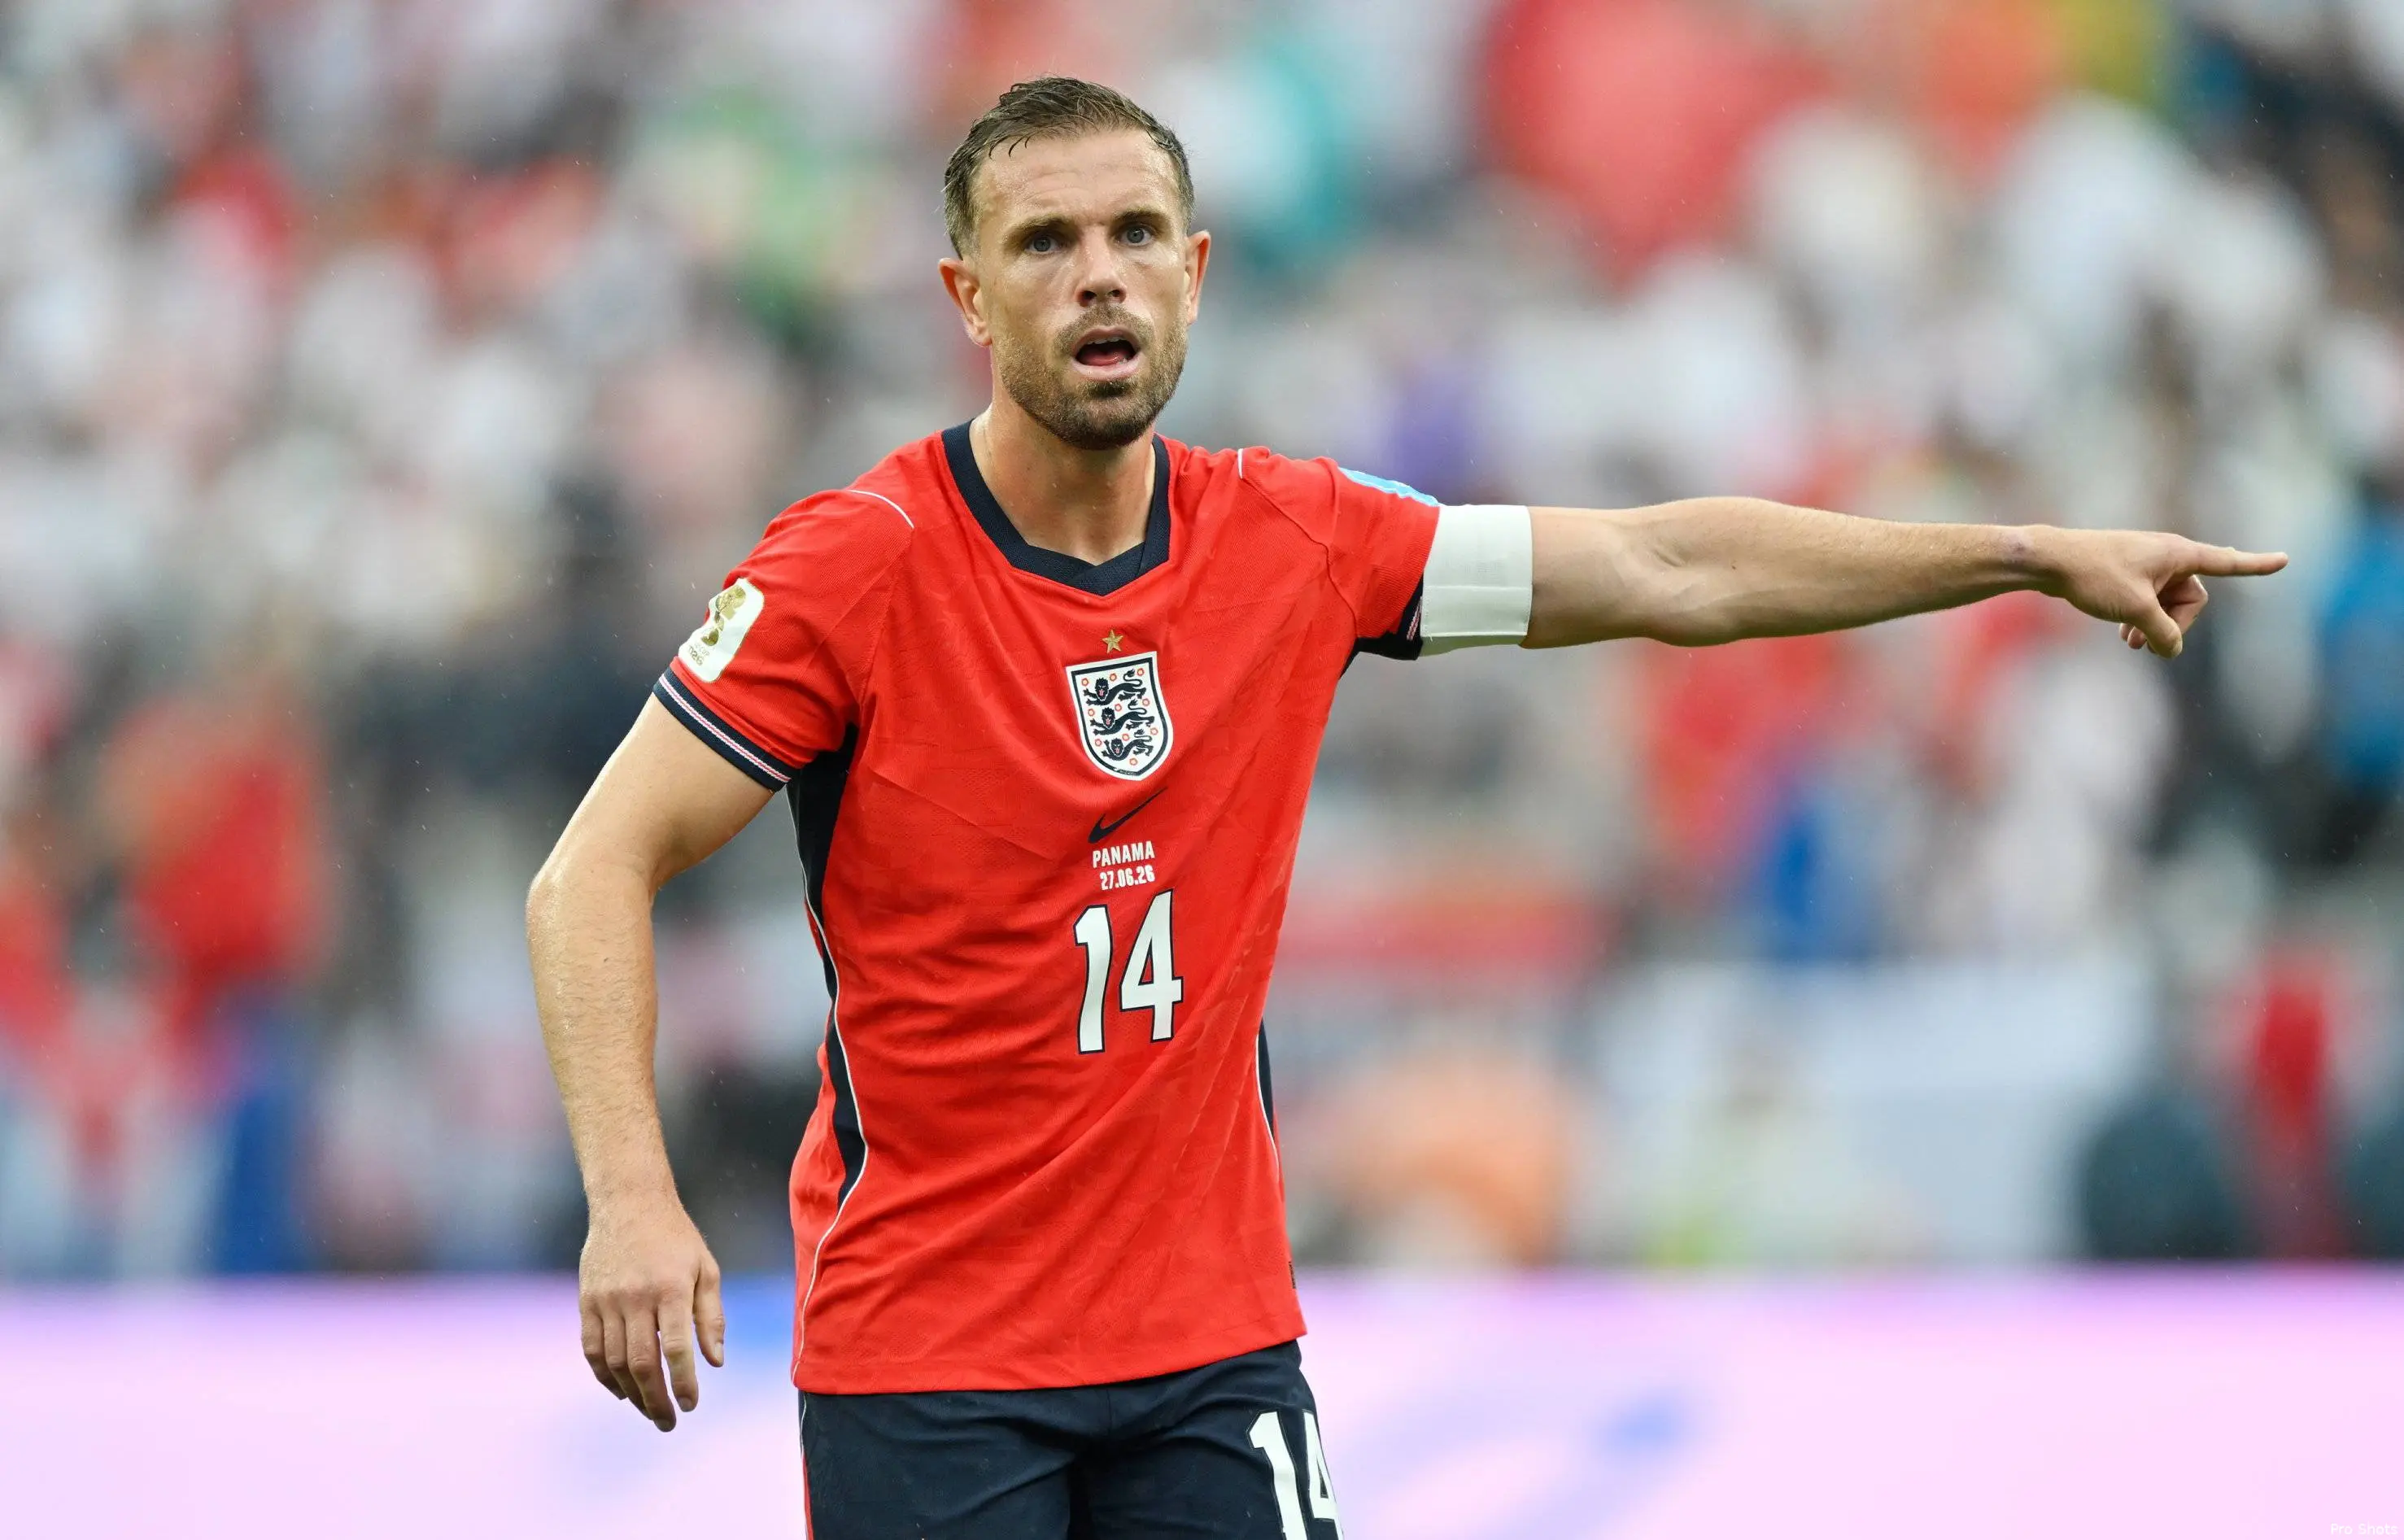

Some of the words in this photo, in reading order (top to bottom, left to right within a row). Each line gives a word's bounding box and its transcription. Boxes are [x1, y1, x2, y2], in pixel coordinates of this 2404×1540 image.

[1093, 840, 1155, 869] PANAMA
[1099, 864, 1155, 891] 27.06.26
[1073, 888, 1184, 1054] 14
[1246, 1409, 1345, 1540] 14
